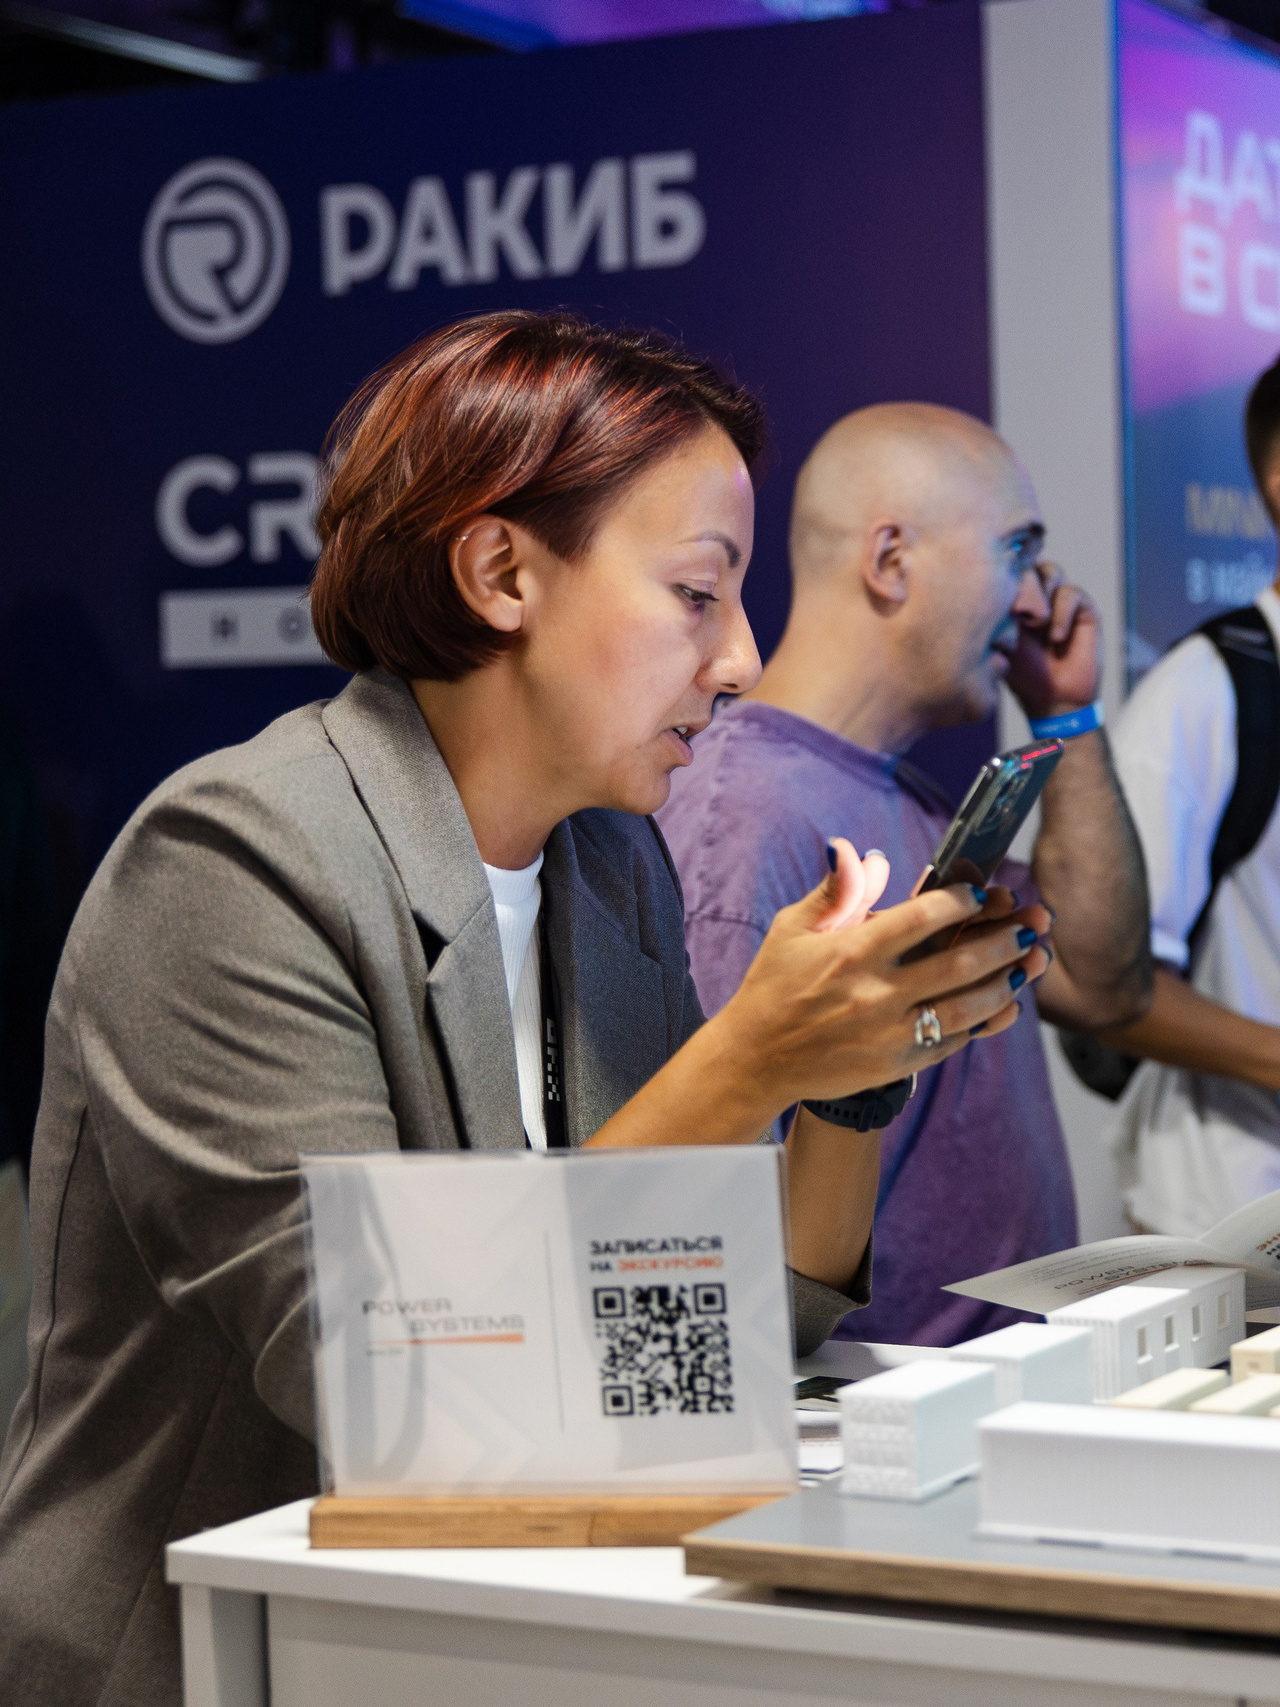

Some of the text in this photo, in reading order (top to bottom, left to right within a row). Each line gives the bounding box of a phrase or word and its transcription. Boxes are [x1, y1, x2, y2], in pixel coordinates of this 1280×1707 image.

[319, 150, 706, 296] РАКИБ
[1180, 222, 1226, 317] В
[590, 1236, 723, 1255] ЗАПИСАТЬСЯ
[1054, 1264, 1136, 1290] POWER
[362, 1298, 452, 1315] POWER
[410, 1314, 525, 1333] SYSTEMS
